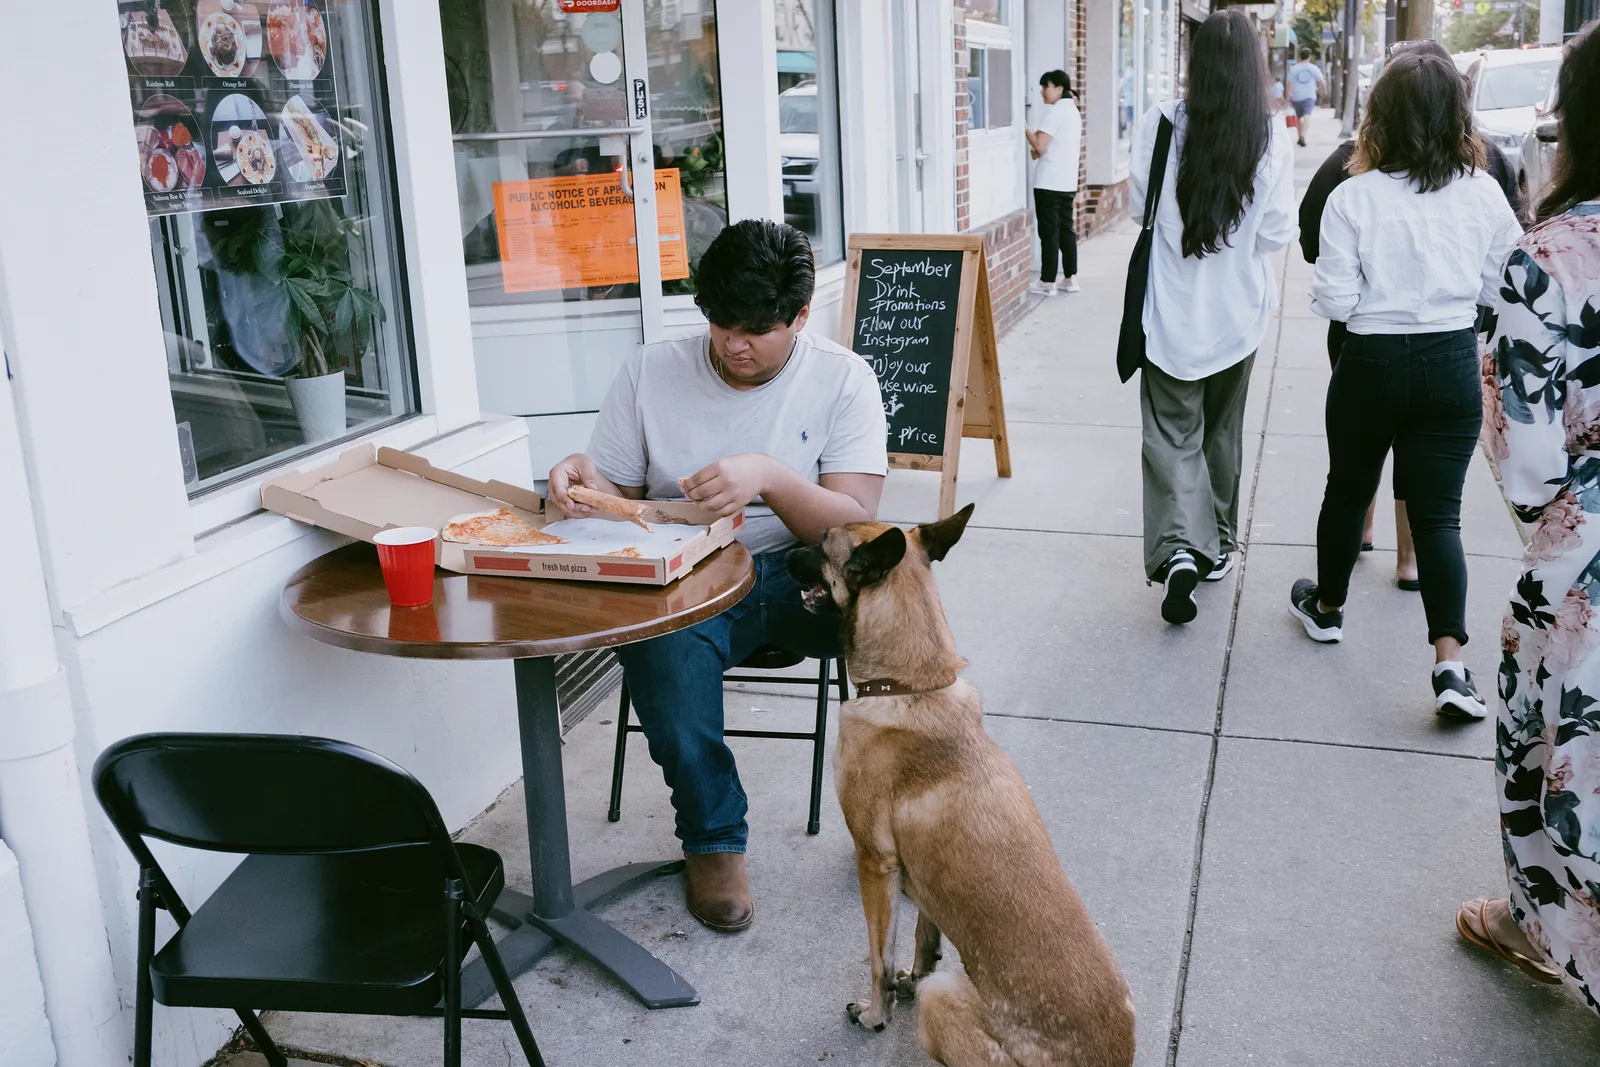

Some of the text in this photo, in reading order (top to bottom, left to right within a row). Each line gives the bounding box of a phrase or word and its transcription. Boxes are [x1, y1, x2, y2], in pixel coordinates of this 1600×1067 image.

[636, 82, 645, 117] PUSH
[253, 187, 267, 195] Delight
[509, 191, 545, 203] PUBLIC
[548, 188, 584, 200] NOTICE
[587, 186, 600, 197] OF
[531, 196, 634, 212] ALCOHOLIC BEVERAG
[866, 257, 952, 283] September
[868, 279, 920, 301] Drink
[870, 299, 946, 314] Promotions
[900, 315, 929, 330] our
[861, 334, 929, 353] Instagram
[905, 362, 931, 374] our
[880, 380, 937, 394] use wine
[898, 426, 938, 446] price
[542, 562, 587, 573] fresh hot pizza
